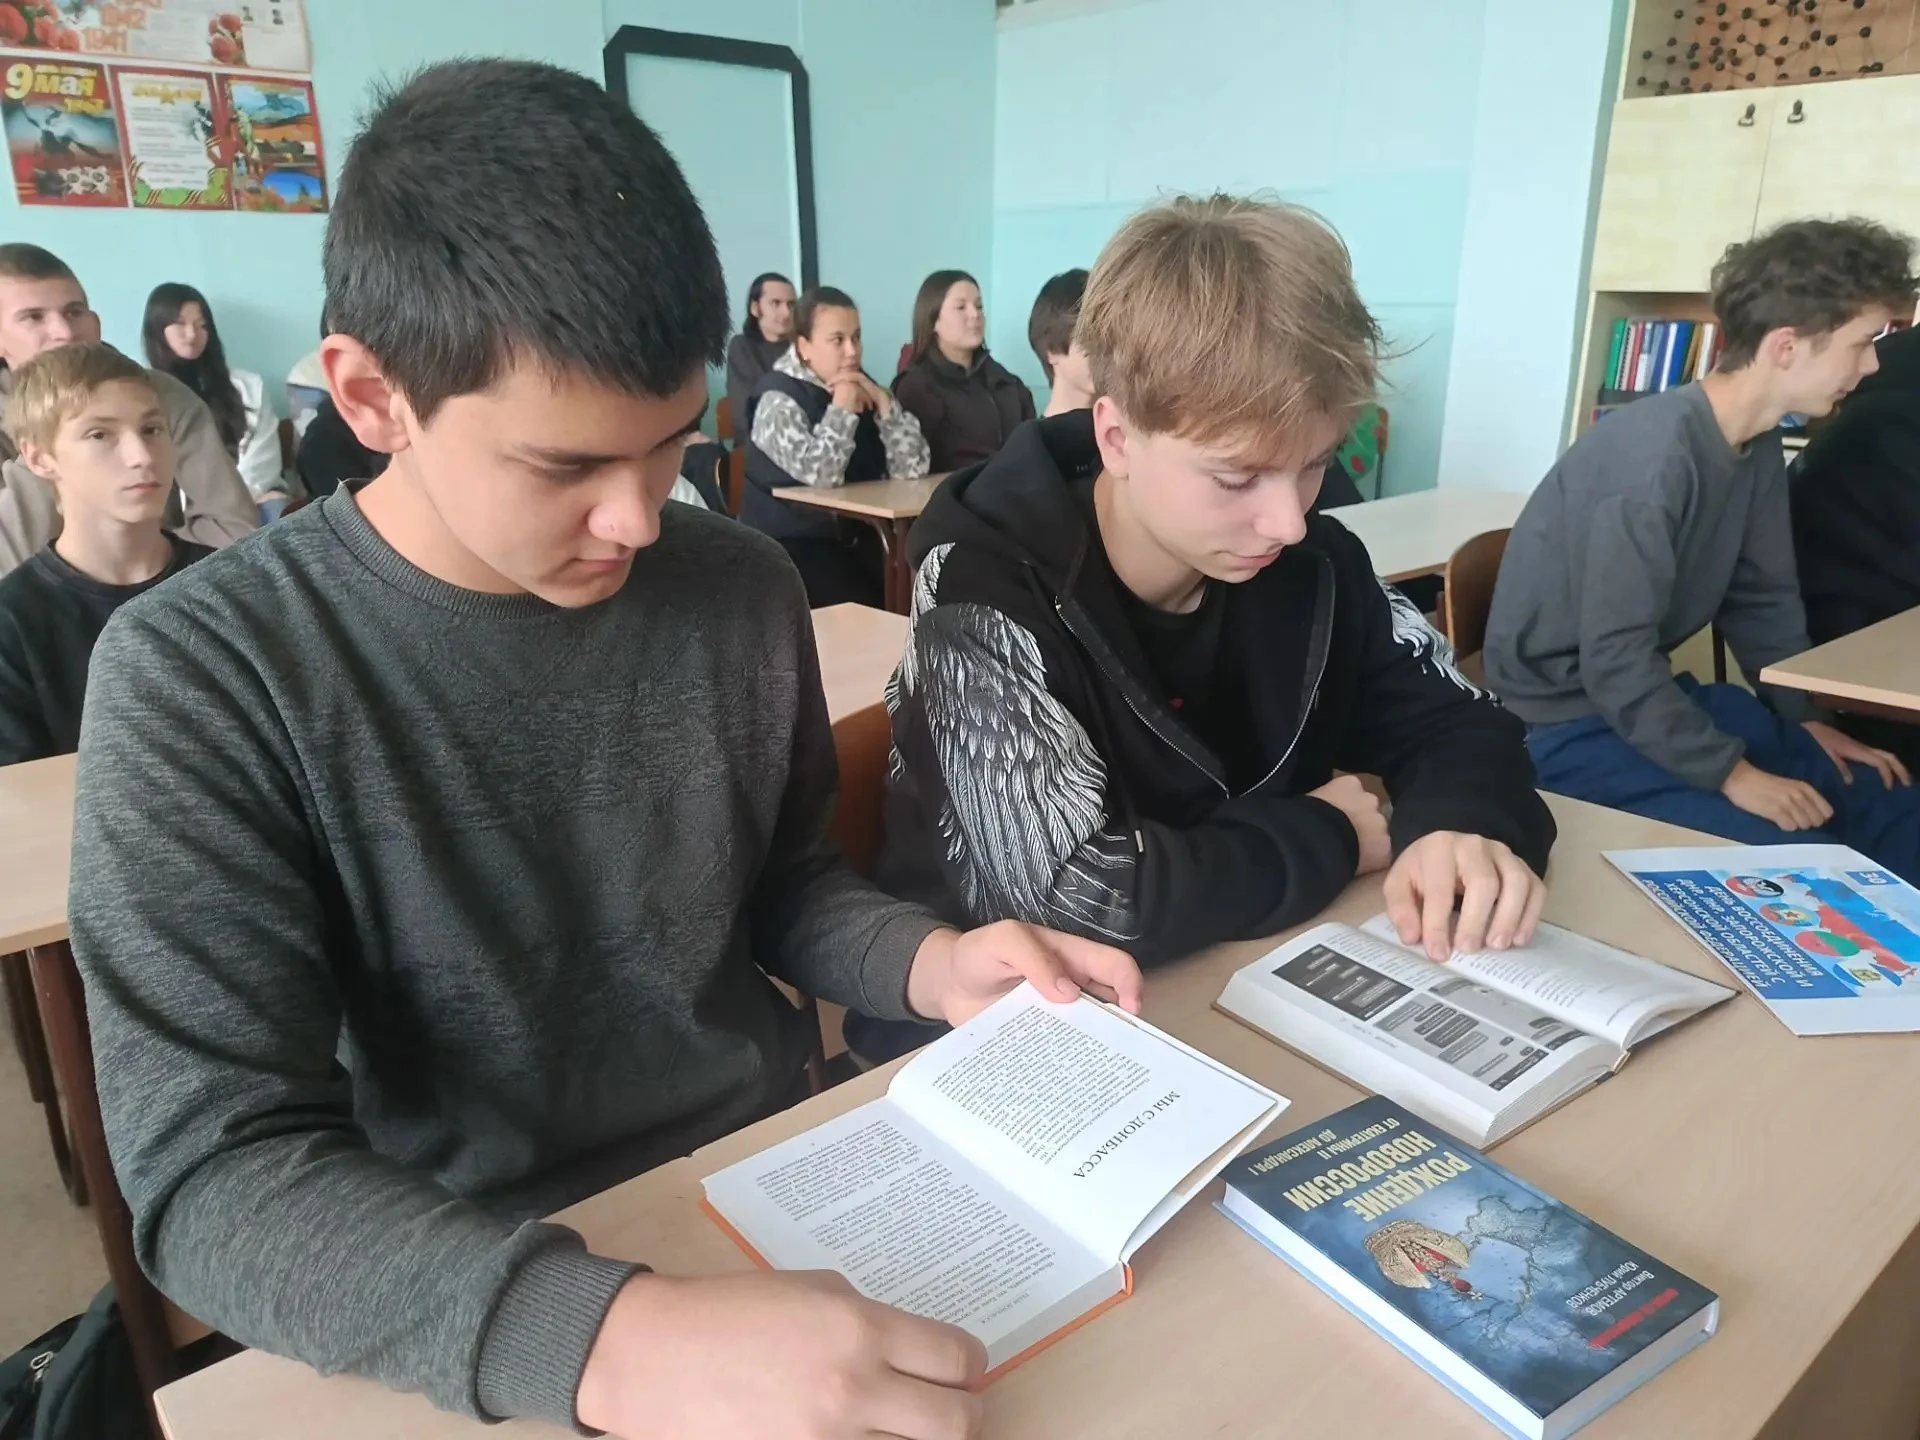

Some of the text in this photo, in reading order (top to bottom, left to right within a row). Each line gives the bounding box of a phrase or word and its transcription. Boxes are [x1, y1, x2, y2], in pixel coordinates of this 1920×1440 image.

[5, 63, 33, 100] 9
[1640, 879, 1773, 987] РОССИЙСКОЙ ФЕДЕРАЦИЕЙ
[1661, 882, 1731, 931] ХЕРСОНСКОЙ
[1717, 932, 1782, 976] ОБЛАСТЕЙ
[1702, 885, 1825, 976] ДЕНЬ ВОССОЕДИНЕНИЯ
[1719, 915, 1806, 977] ЗАПОРОЖСКОЙ
[1793, 979, 1816, 987] И
[1070, 1088, 1183, 1181] МЫ С ДОНБАССА
[1251, 1136, 1323, 1172] АЛЕКСАНДРА
[1280, 1129, 1437, 1212] НОВОРОССИИ
[1314, 1127, 1339, 1142] ДО
[1315, 1116, 1401, 1160] ОТ ЕКАТЕРИНЫ II
[1340, 1149, 1473, 1222] РОЖДЕНИЕ
[1563, 1259, 1640, 1308] Юрий ЛУБЧЕНКОВ
[1582, 1269, 1655, 1316] Виктор АРТЕМОВ
